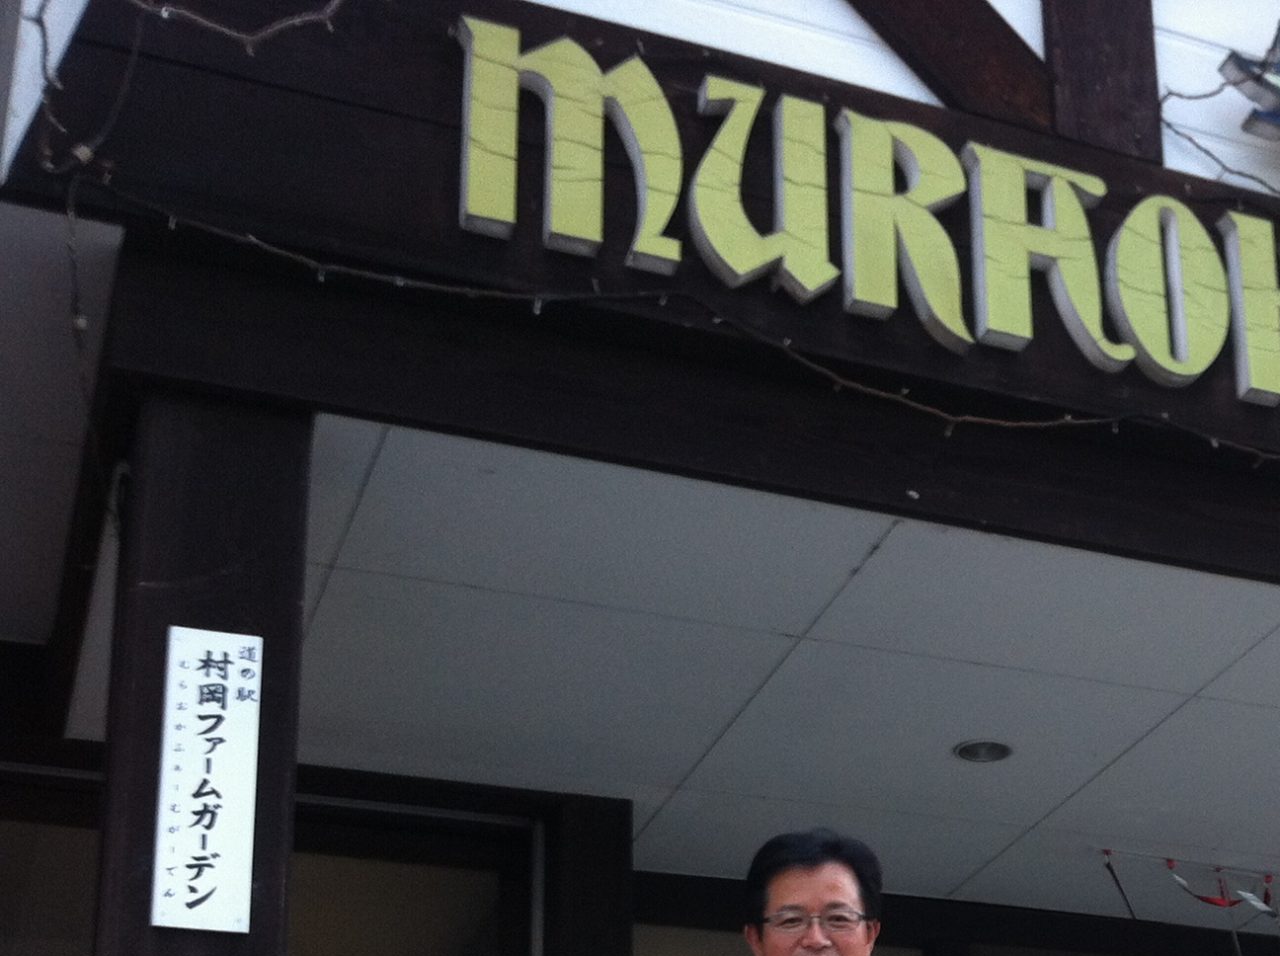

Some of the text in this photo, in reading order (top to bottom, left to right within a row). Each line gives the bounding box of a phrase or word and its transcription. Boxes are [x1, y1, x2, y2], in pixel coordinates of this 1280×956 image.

[236, 646, 258, 702] 道の駅
[185, 650, 234, 909] 村岡ファームガーデン
